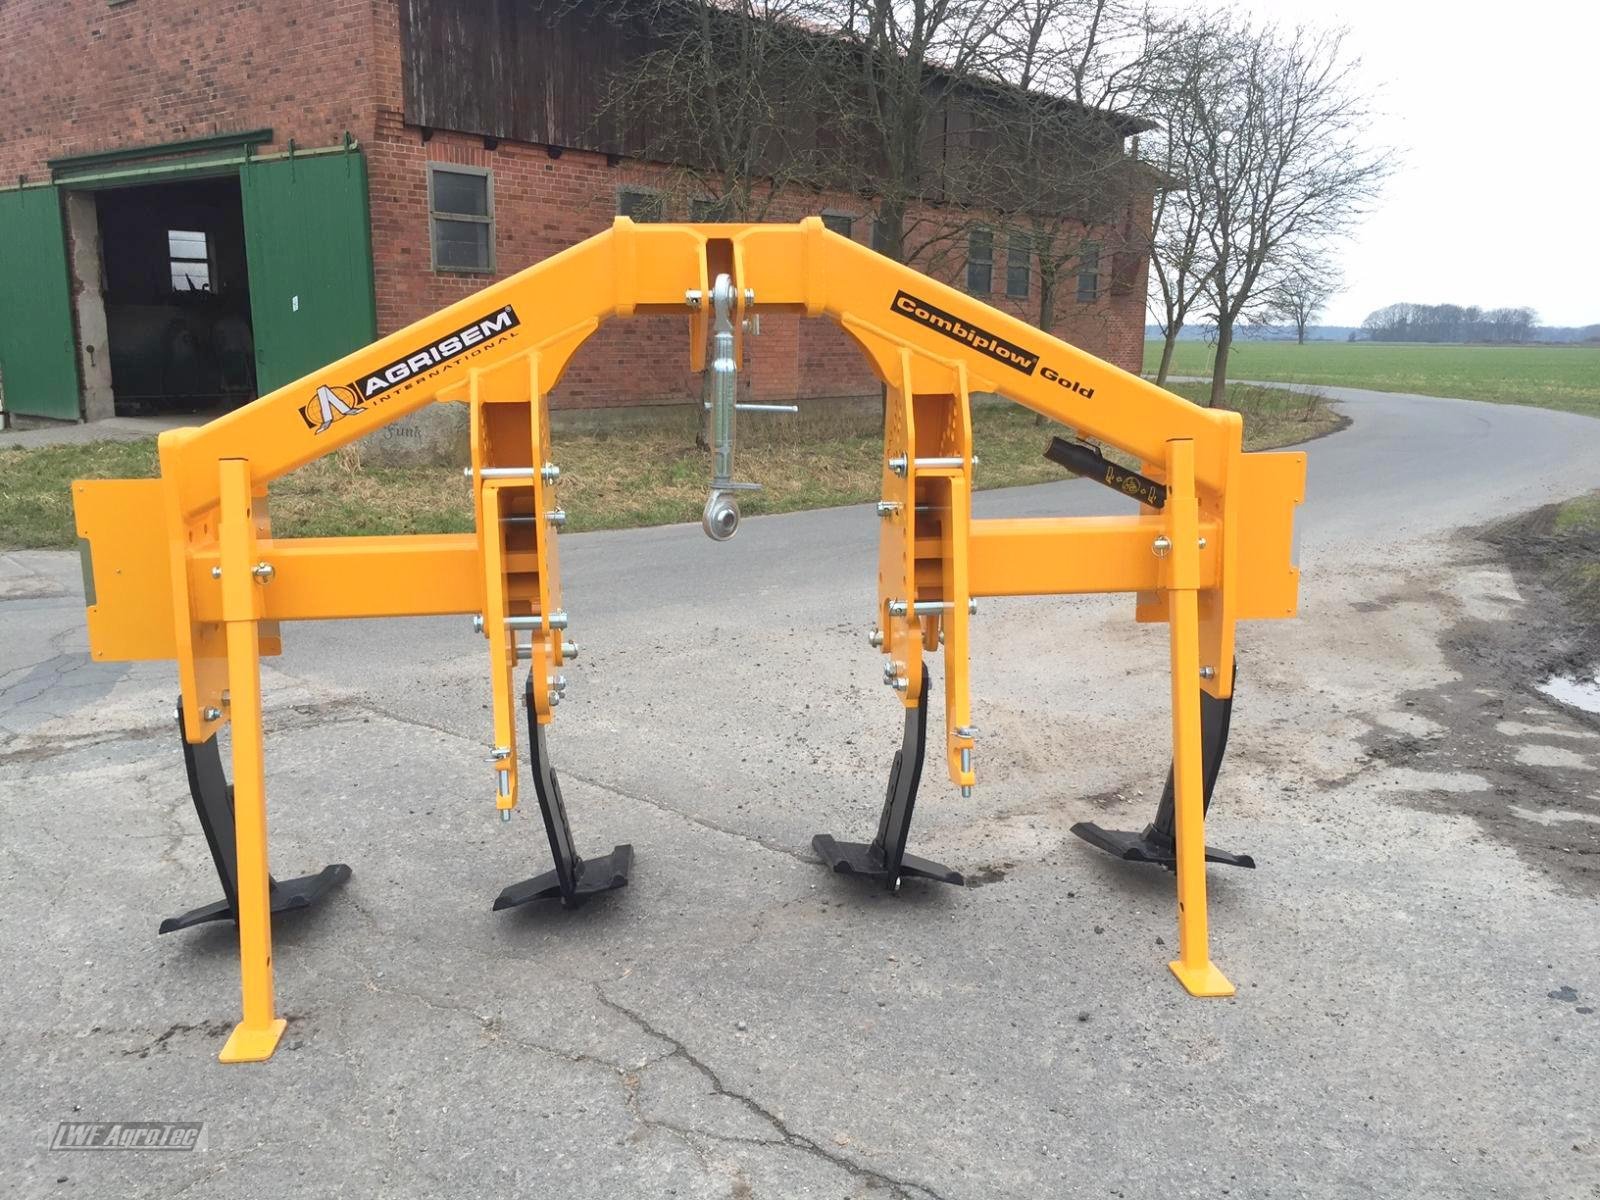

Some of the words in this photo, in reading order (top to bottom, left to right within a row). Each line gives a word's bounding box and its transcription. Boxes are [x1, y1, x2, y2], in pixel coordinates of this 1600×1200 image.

[365, 310, 513, 397] AGRISEM
[372, 331, 520, 406] INTERNATIONAL
[896, 297, 1033, 369] Combiplow
[1039, 366, 1095, 400] Gold
